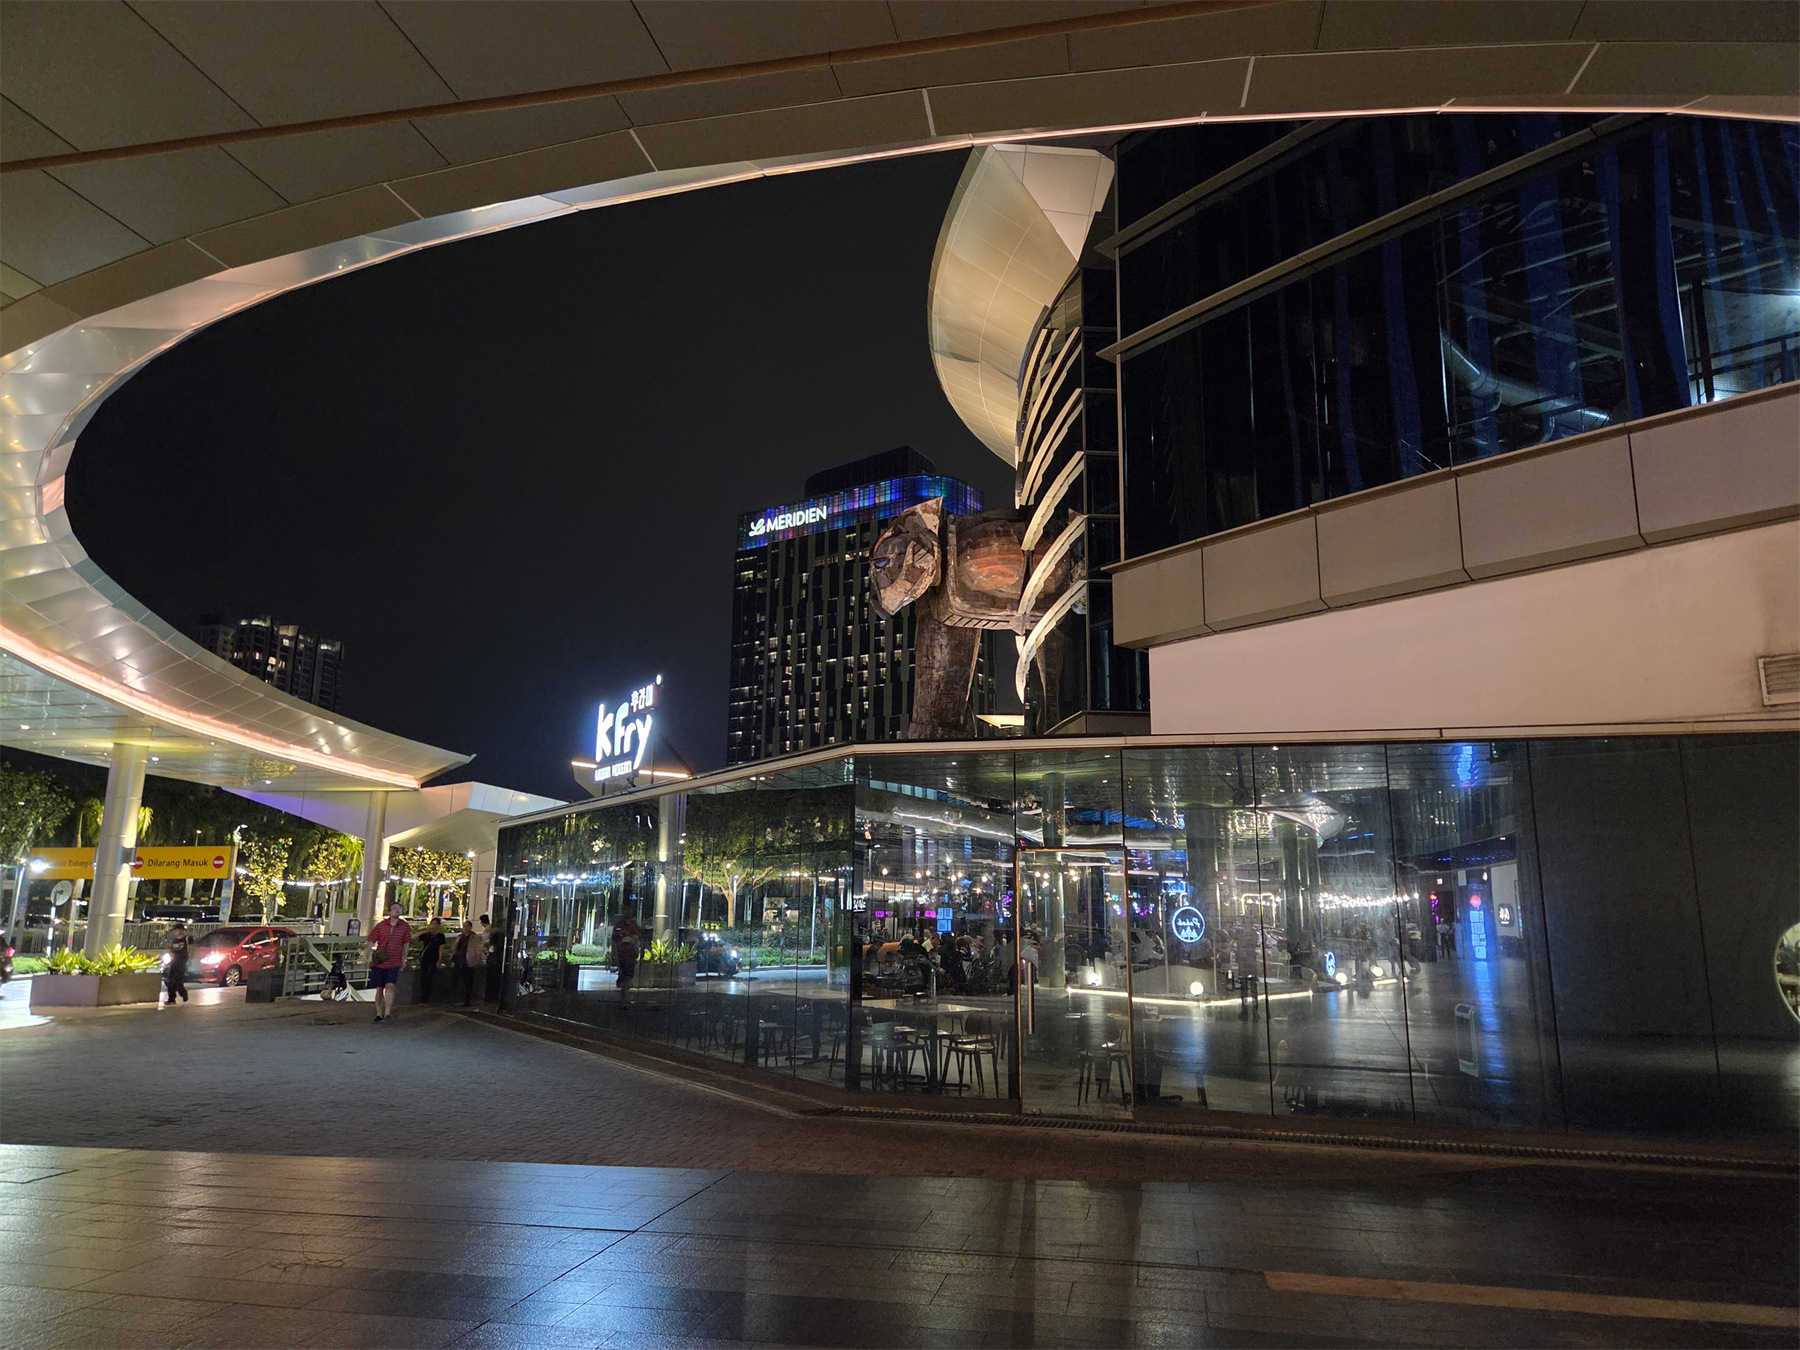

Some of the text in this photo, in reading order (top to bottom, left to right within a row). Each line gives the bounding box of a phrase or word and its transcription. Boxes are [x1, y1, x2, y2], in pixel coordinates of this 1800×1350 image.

[766, 505, 827, 533] MERIDIEN
[147, 858, 208, 869] Dilarang Masuk
